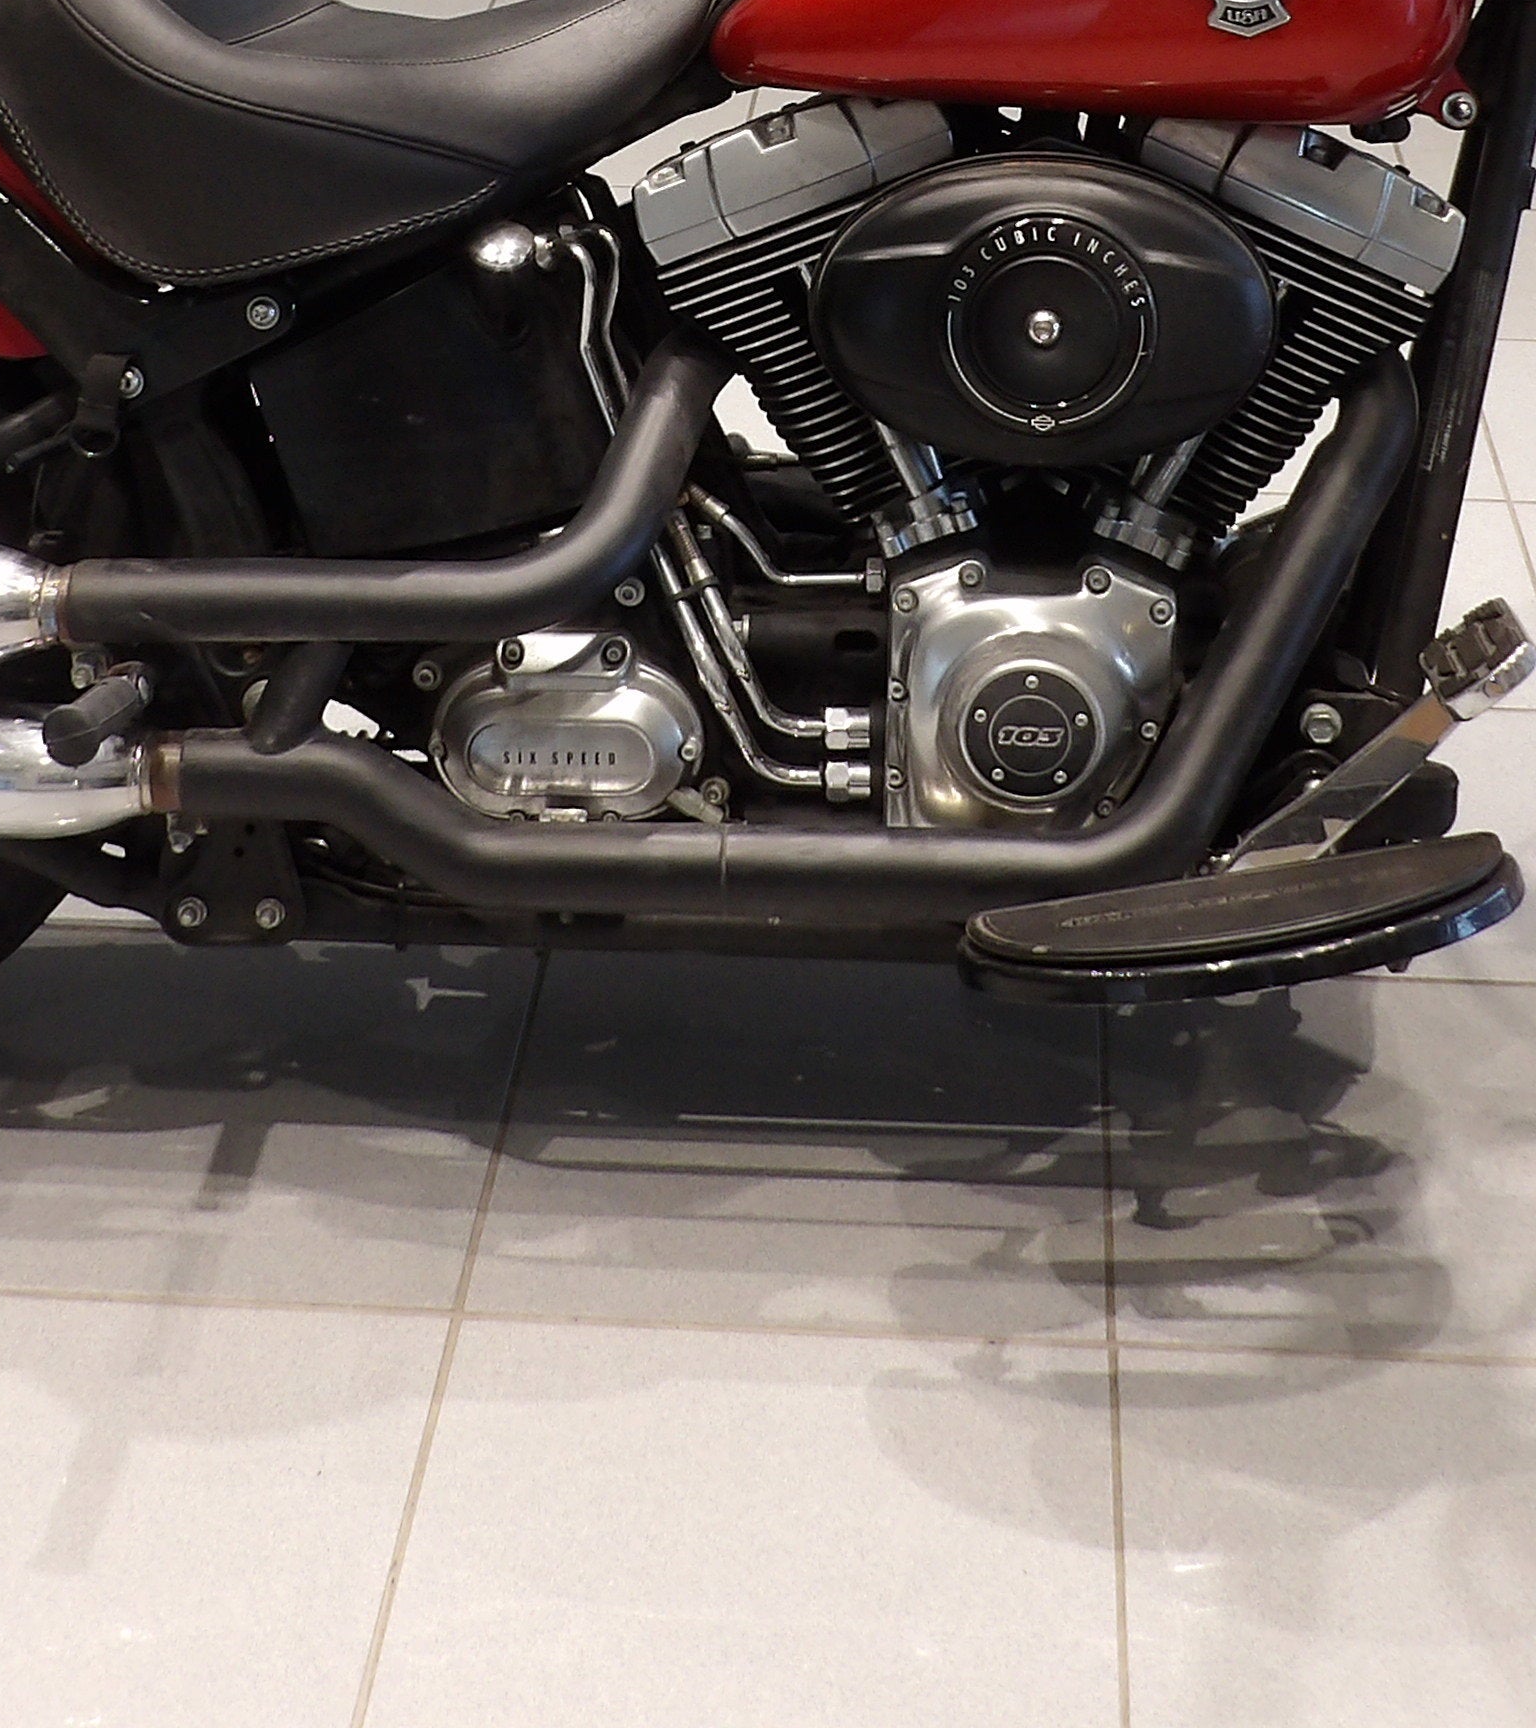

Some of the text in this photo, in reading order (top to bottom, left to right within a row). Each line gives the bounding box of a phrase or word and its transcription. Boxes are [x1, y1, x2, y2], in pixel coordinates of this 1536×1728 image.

[1226, 8, 1269, 25] USA
[947, 226, 1146, 309] 103 CUBIC INCHES
[998, 725, 1065, 748] 103
[503, 751, 616, 765] SIX SPEED
